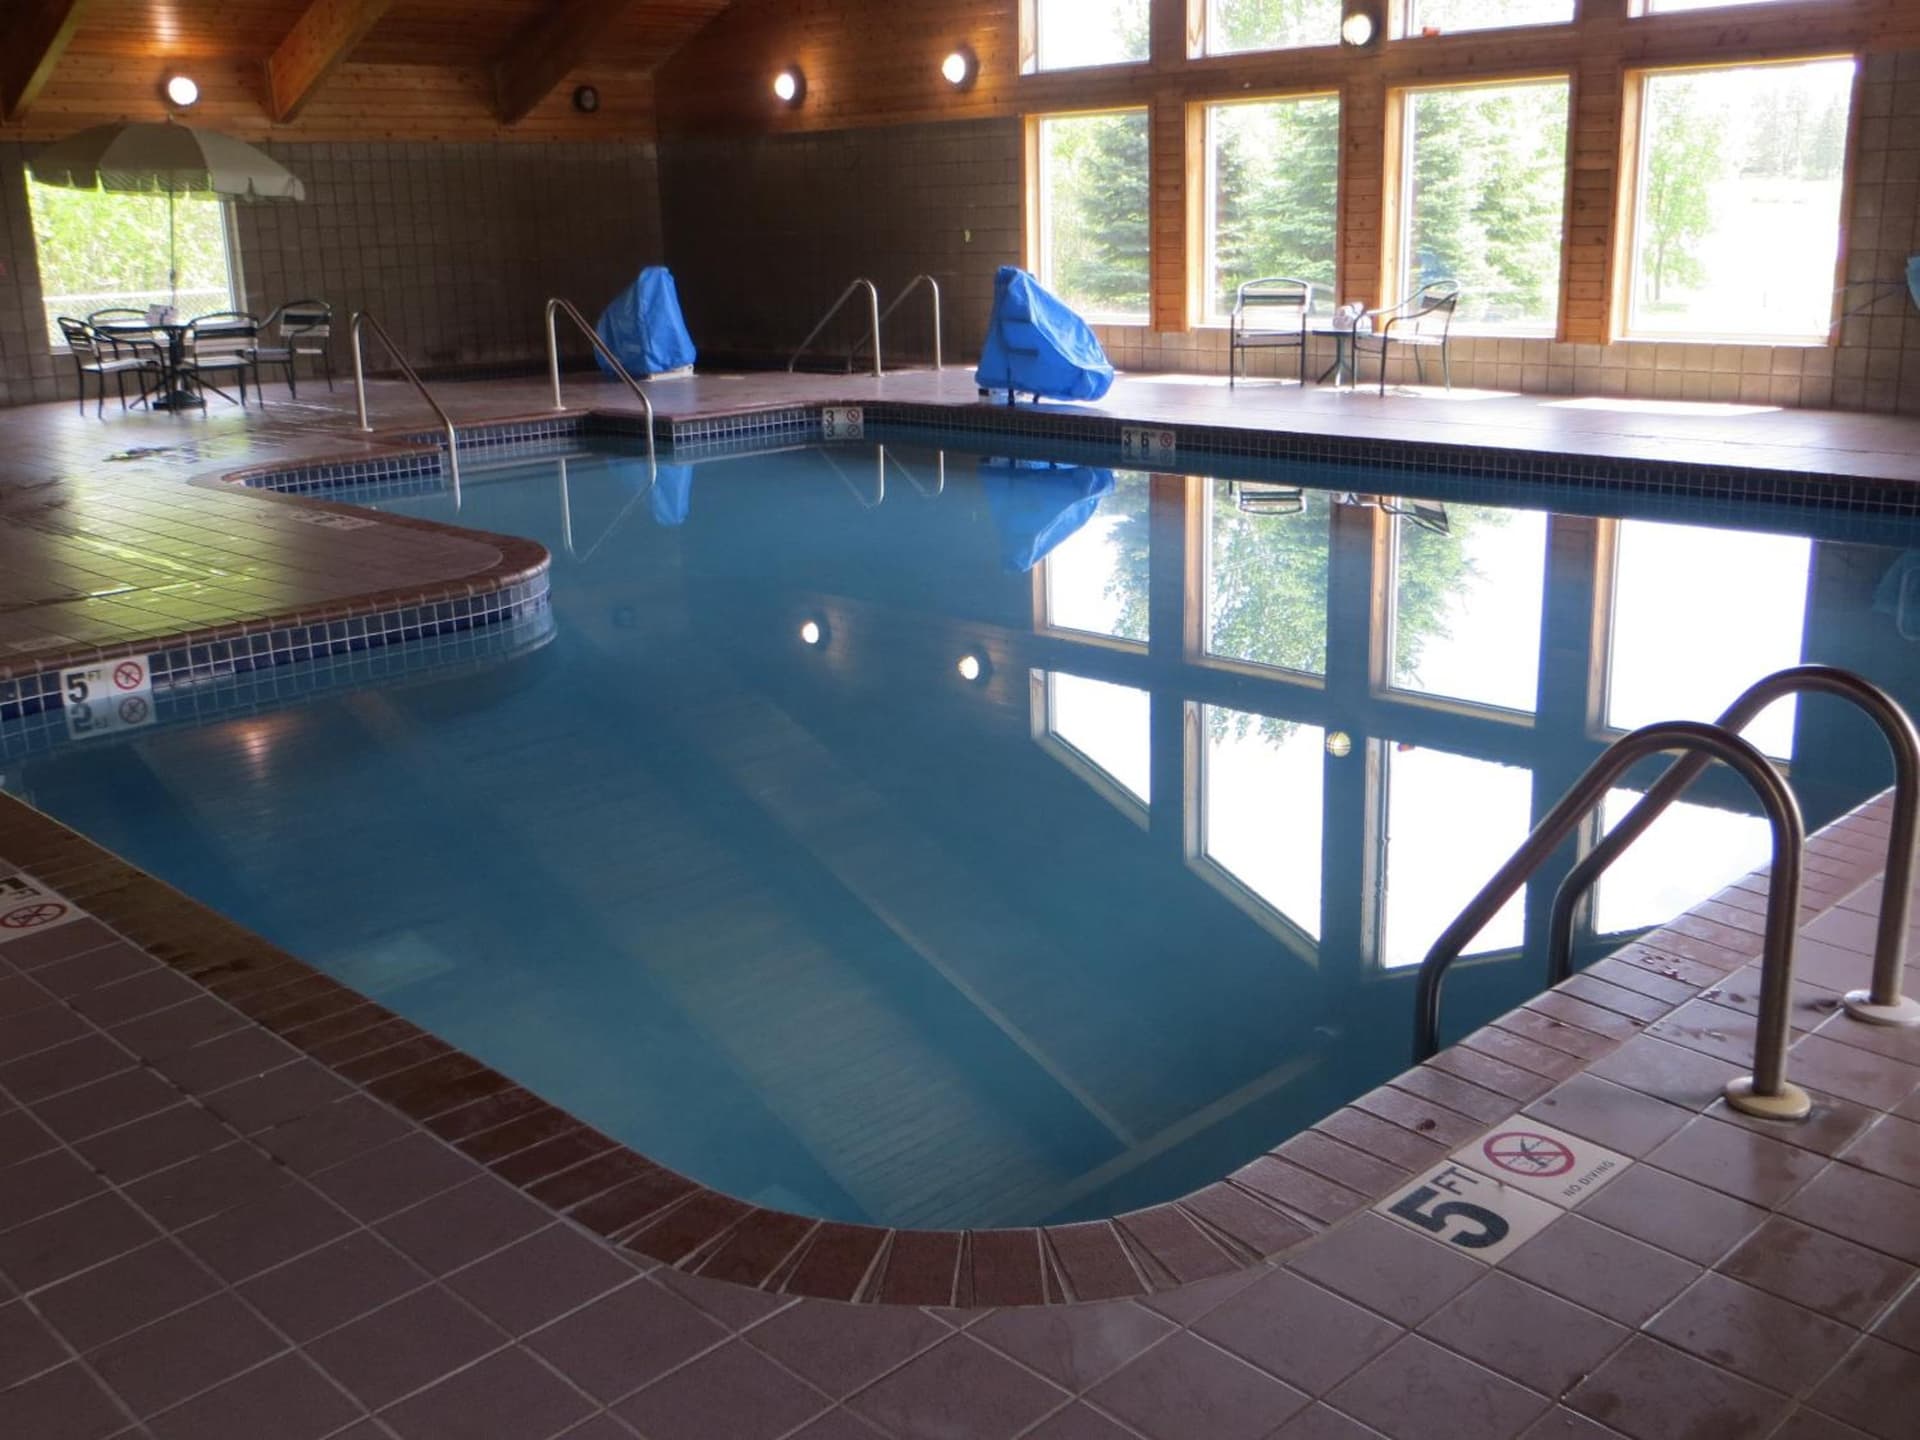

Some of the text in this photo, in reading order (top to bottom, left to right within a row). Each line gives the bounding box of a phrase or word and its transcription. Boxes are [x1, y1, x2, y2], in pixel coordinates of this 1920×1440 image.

[825, 410, 835, 425] 3
[1124, 430, 1150, 448] 3 6
[66, 671, 89, 704] 5
[1562, 1161, 1616, 1197] NO DIVING
[1388, 1166, 1510, 1249] 5 FT
